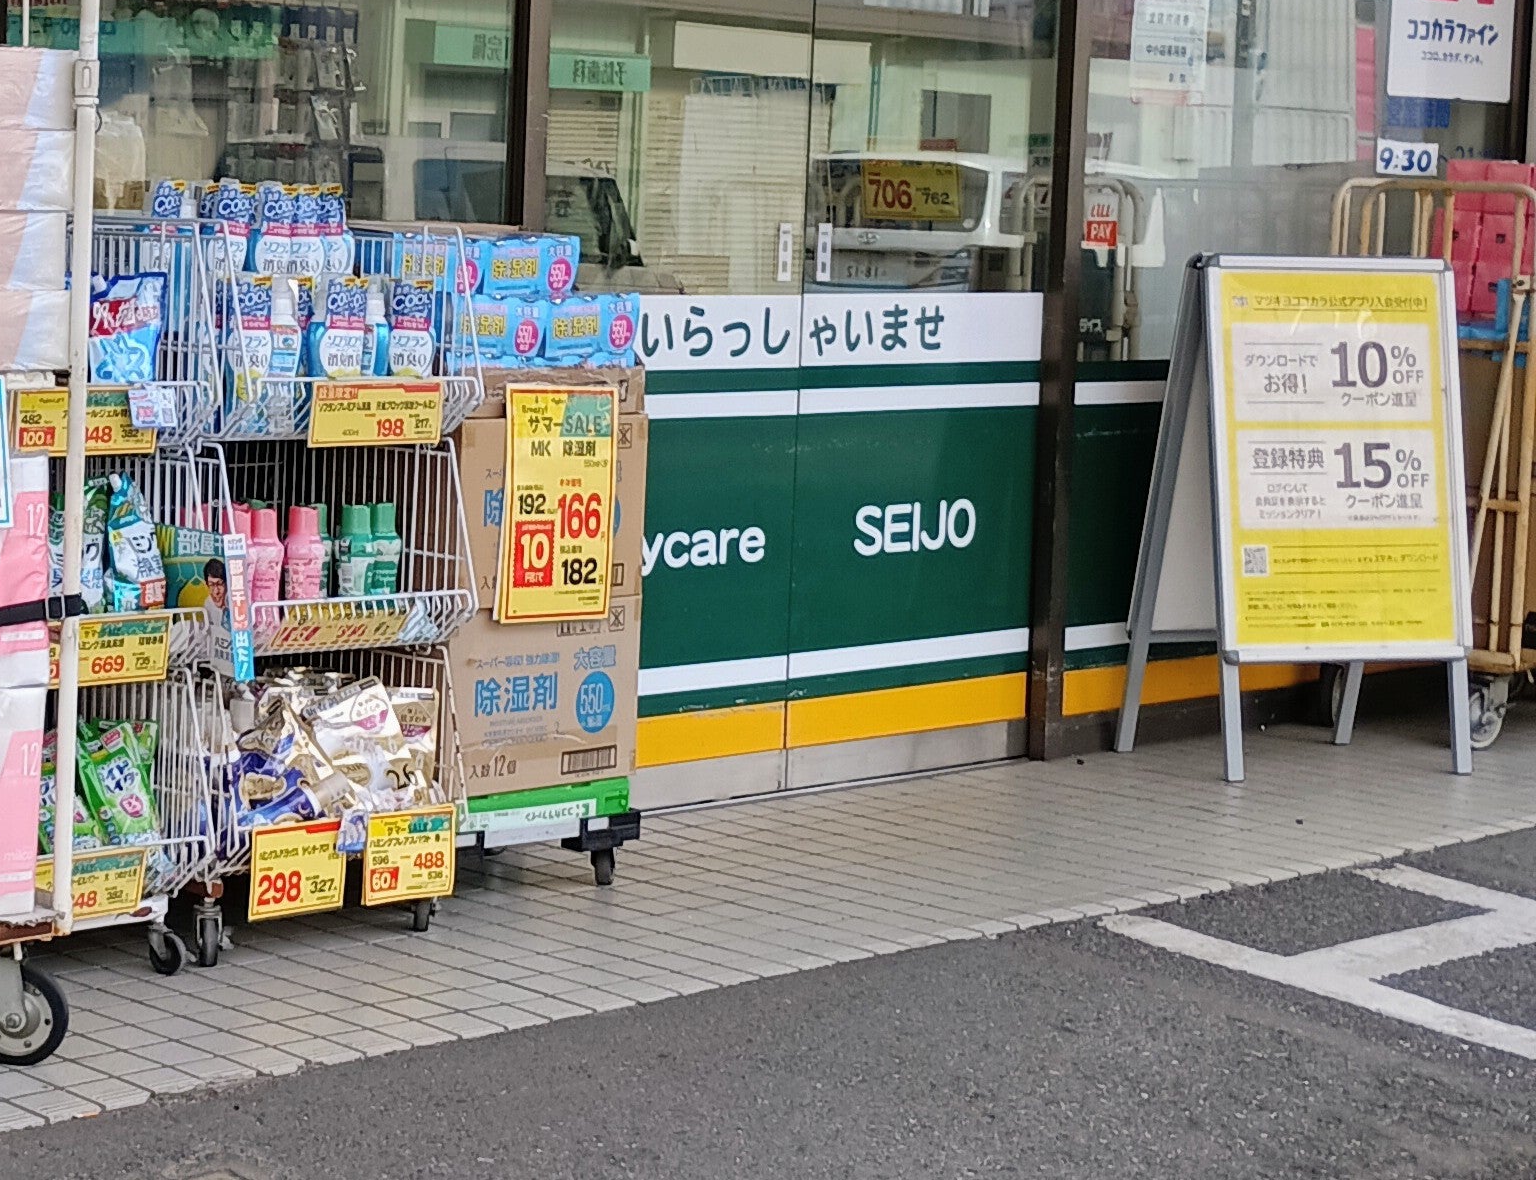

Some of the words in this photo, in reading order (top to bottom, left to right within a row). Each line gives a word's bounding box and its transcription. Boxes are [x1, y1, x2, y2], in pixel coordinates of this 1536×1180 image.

[1407, 18, 1499, 47] ココカラファイン
[1379, 146, 1432, 173] 9:30
[868, 177, 914, 211] 706
[640, 304, 946, 359] いらっしゃいませ
[1244, 353, 1319, 369] ダウンロードで
[1263, 371, 1309, 395] お得!
[1392, 369, 1423, 385] OFF
[1340, 391, 1417, 408] クーポン進呈
[376, 418, 405, 438] 198
[530, 440, 552, 457] MK
[1252, 447, 1325, 470] 登録特典
[1396, 473, 1430, 489] OFF
[1345, 493, 1423, 510] クーポン進呈
[27, 504, 48, 537] 12
[518, 493, 546, 515] 192
[557, 493, 602, 539] 166
[853, 497, 978, 557] SEIJO
[520, 532, 550, 570] 10
[561, 557, 597, 586] 182
[91, 655, 126, 675] 669
[574, 645, 617, 669] 大容量
[474, 672, 558, 718] 除湿剤
[21, 741, 40, 779] 12
[413, 850, 446, 870] 488
[256, 870, 302, 907] 298
[310, 877, 336, 895] 327
